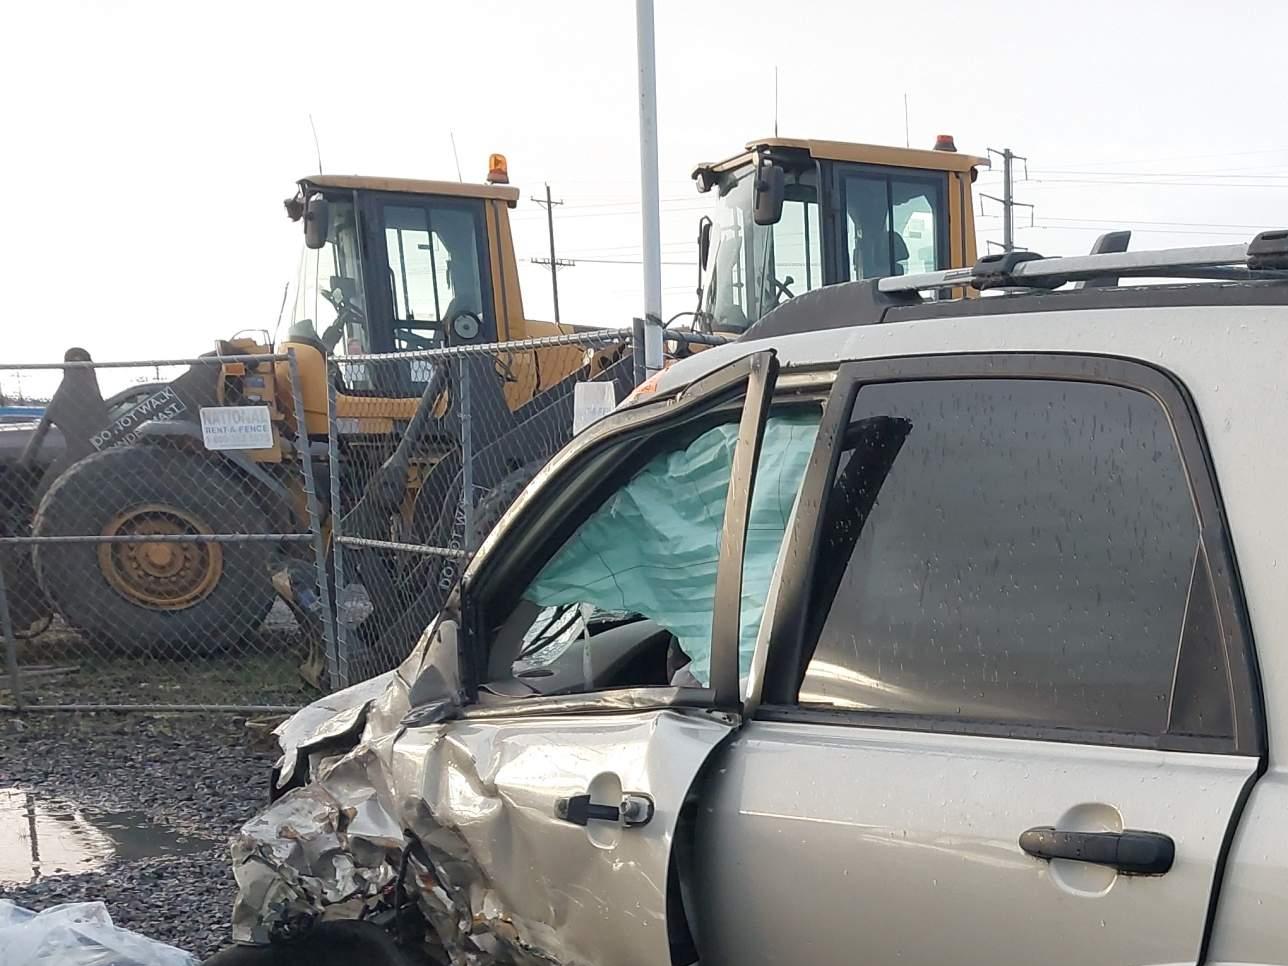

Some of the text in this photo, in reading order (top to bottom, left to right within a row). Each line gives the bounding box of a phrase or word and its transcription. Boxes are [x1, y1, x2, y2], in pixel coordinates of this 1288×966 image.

[90, 385, 174, 451] DO NOT WALK
[440, 566, 455, 590] DO
